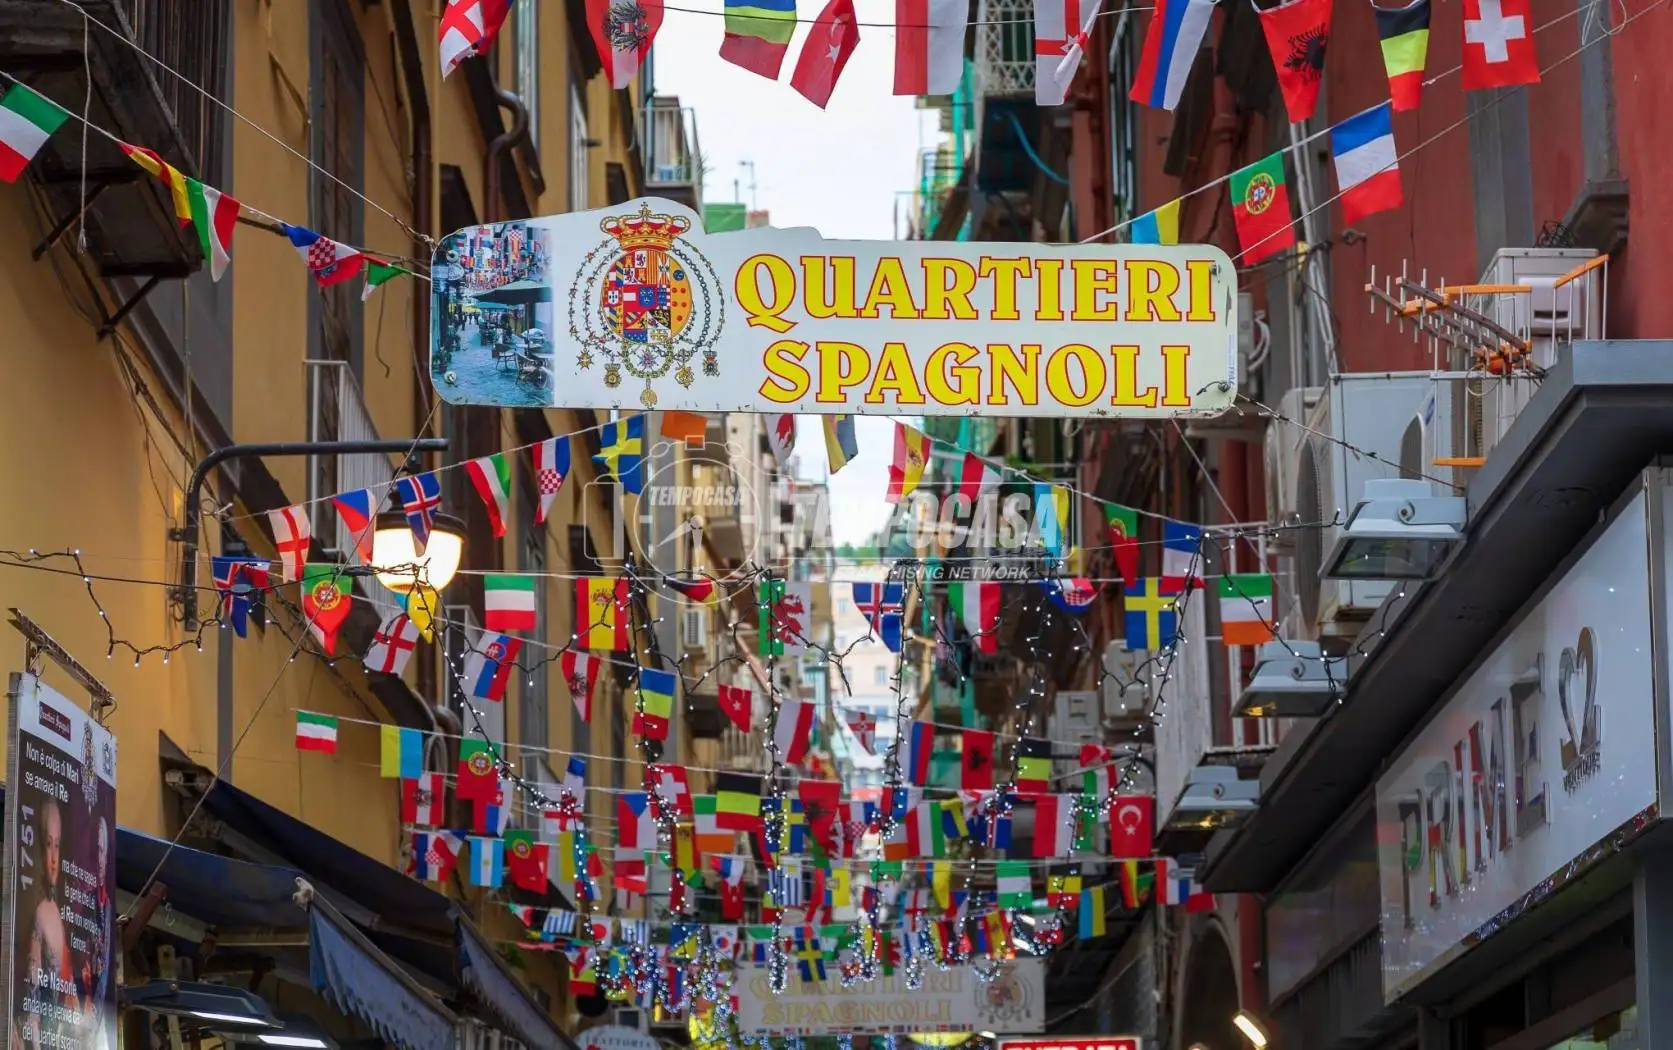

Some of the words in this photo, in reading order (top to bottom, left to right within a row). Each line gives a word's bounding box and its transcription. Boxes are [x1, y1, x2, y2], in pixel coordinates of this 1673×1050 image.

[735, 252, 1217, 333] QUARTIERI
[758, 340, 1191, 408] SPAGNOLI
[26, 741, 39, 762] Non
[45, 754, 60, 775] colpa
[25, 771, 33, 786] se
[35, 775, 54, 796] amava
[59, 784, 68, 803] Re
[1398, 653, 1551, 930] PRIME
[21, 805, 34, 891] 1751
[66, 905, 74, 924] Re
[37, 967, 48, 988] Re
[23, 996, 47, 1016] andava
[762, 998, 953, 1025] SPAGNOLI
